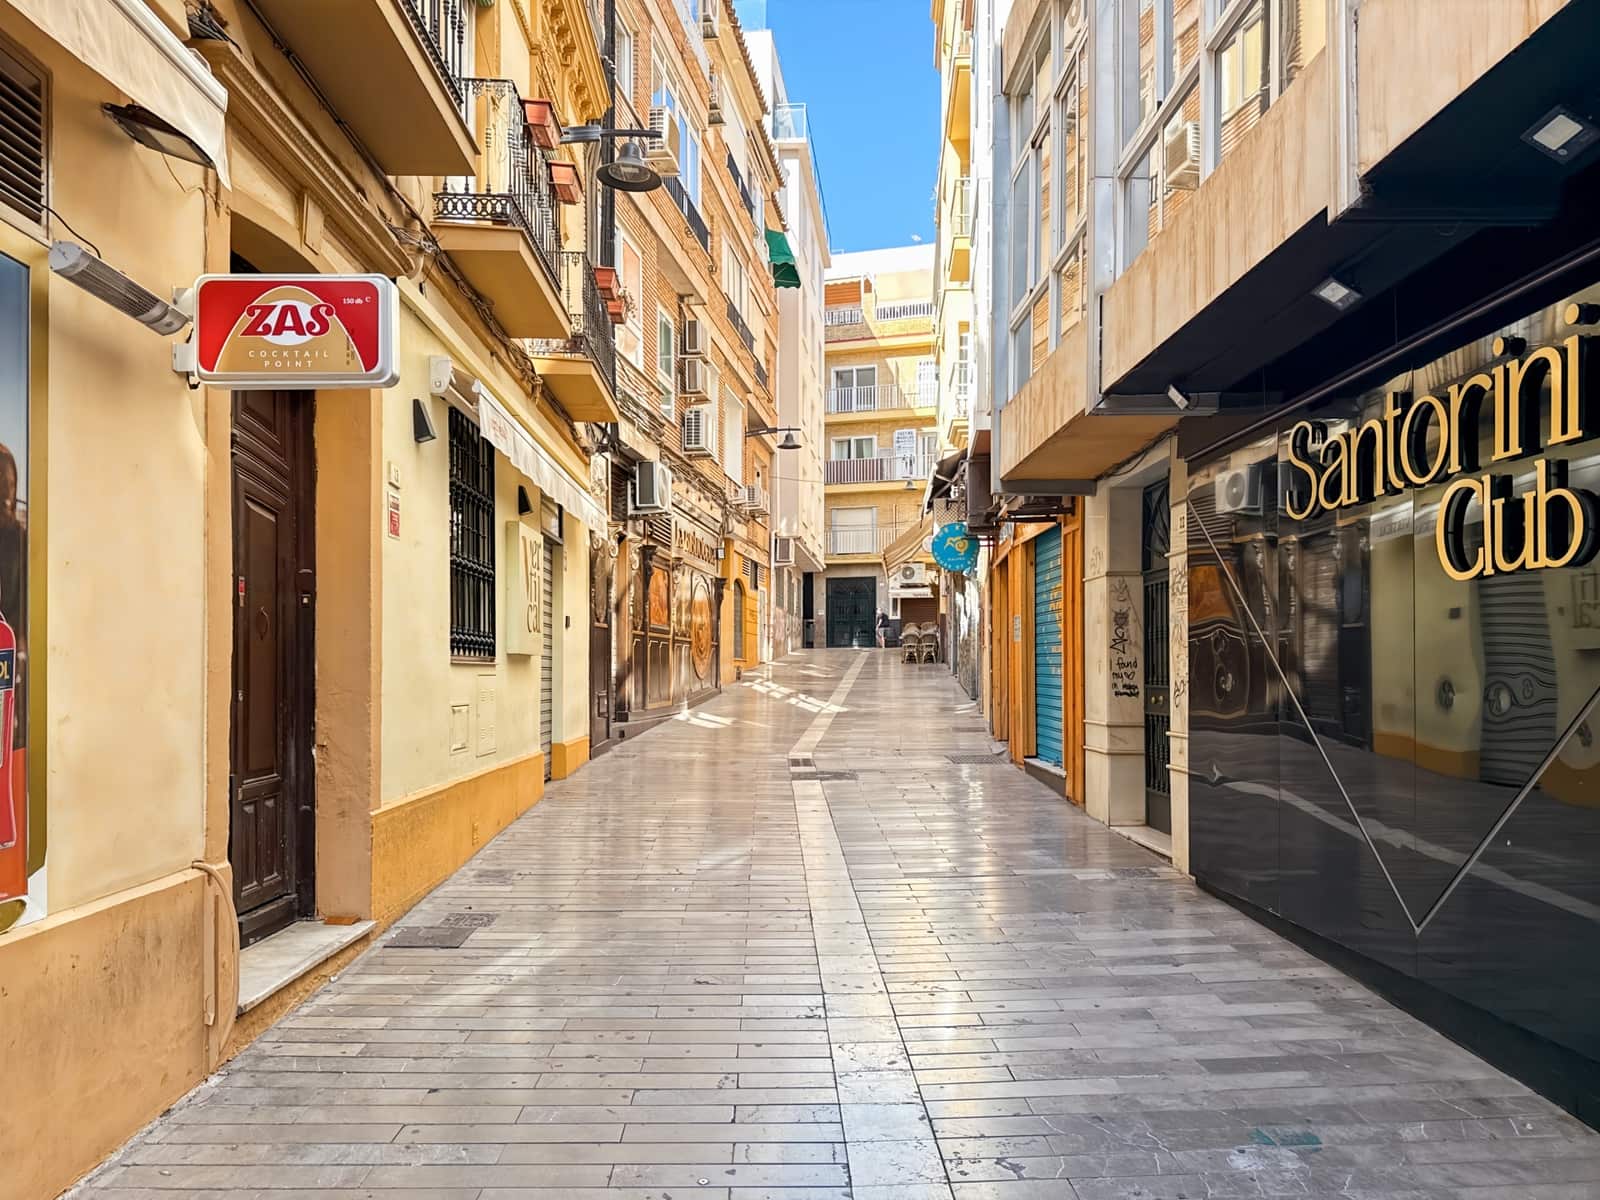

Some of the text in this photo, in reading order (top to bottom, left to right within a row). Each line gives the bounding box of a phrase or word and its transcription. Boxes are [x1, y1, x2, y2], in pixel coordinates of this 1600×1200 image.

[239, 304, 335, 336] ZAS
[248, 350, 329, 358] COCKTAIL
[263, 360, 313, 368] POINT
[1285, 302, 1584, 521] Santorini
[1436, 458, 1584, 581] Club
[1116, 656, 1138, 671] found
